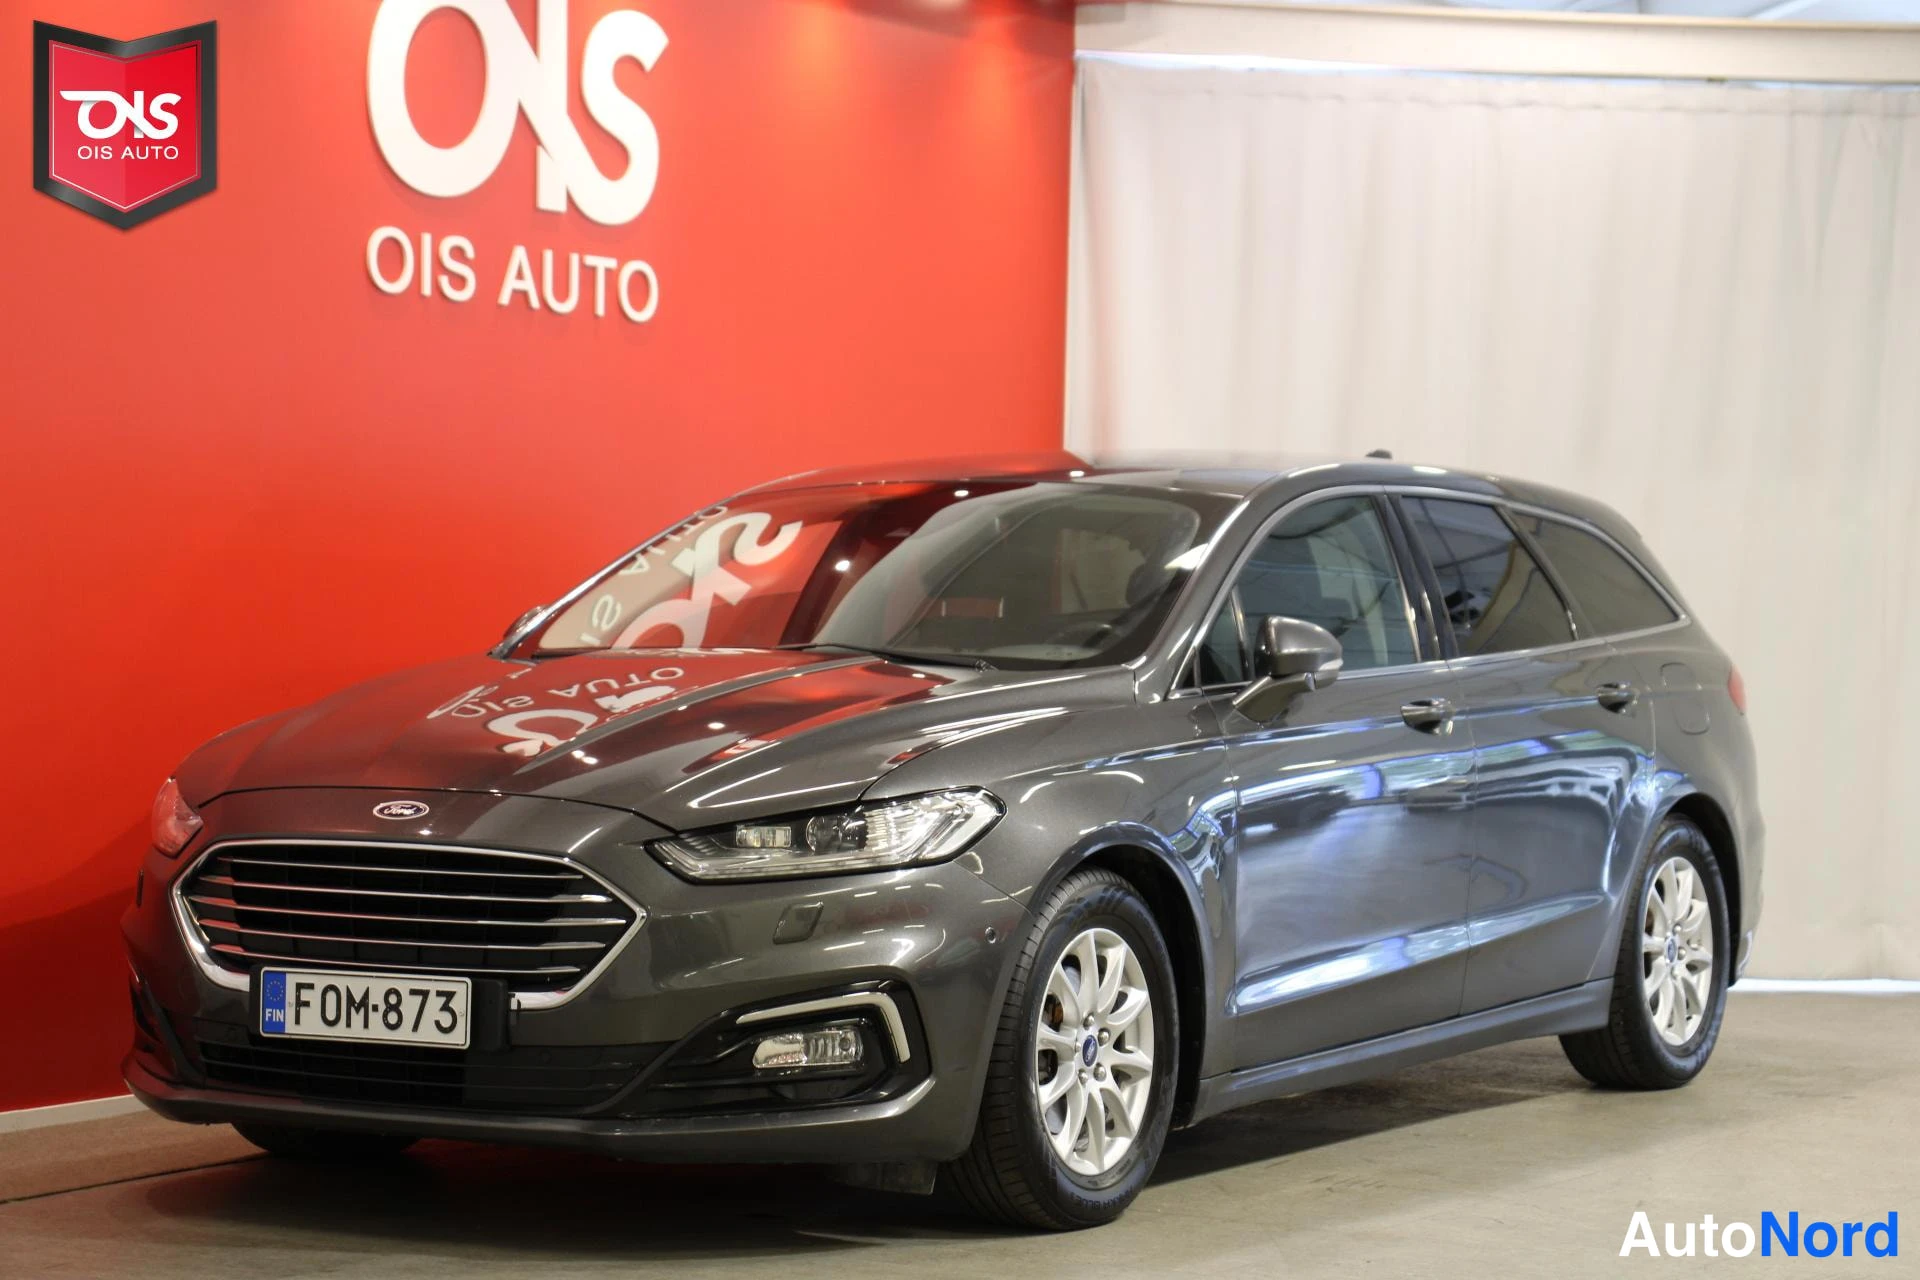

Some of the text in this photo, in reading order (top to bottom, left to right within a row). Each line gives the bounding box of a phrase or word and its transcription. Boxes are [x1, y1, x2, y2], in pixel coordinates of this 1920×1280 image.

[366, 225, 660, 323] OIS AUTO
[265, 1008, 284, 1023] FIN
[294, 982, 458, 1034] FOM-873
